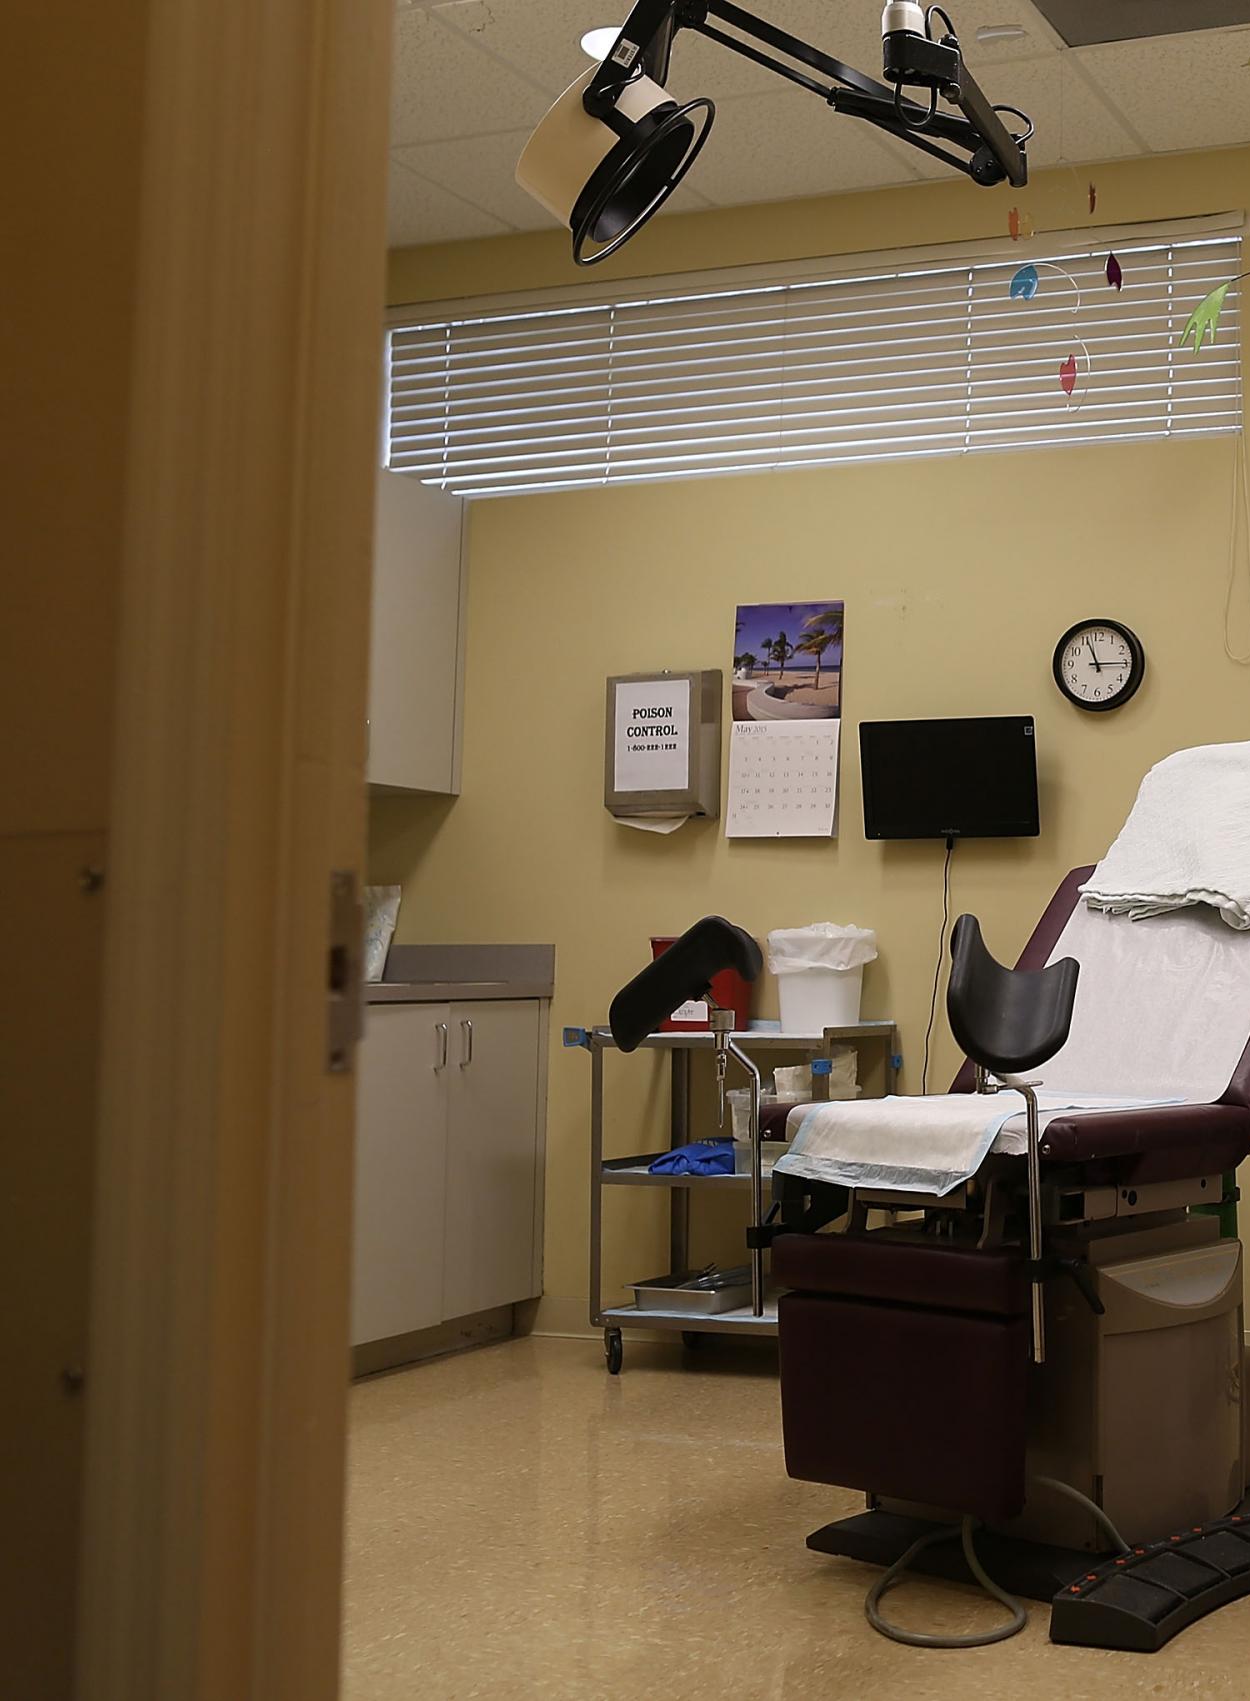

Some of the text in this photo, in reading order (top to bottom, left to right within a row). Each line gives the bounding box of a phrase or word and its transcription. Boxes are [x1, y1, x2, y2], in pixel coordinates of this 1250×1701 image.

[1094, 632, 1105, 641] 12
[1110, 635, 1114, 645] 1
[1071, 646, 1081, 656] 10
[1118, 645, 1125, 655] 2
[1067, 660, 1074, 670] 9
[1071, 674, 1078, 684] 8
[1116, 673, 1123, 683] 4
[1081, 684, 1088, 694] 7
[1094, 688, 1101, 697] 6
[1107, 684, 1114, 694] 5
[632, 707, 673, 719] POISON
[627, 725, 678, 737] CONTROL
[736, 724, 751, 735] May
